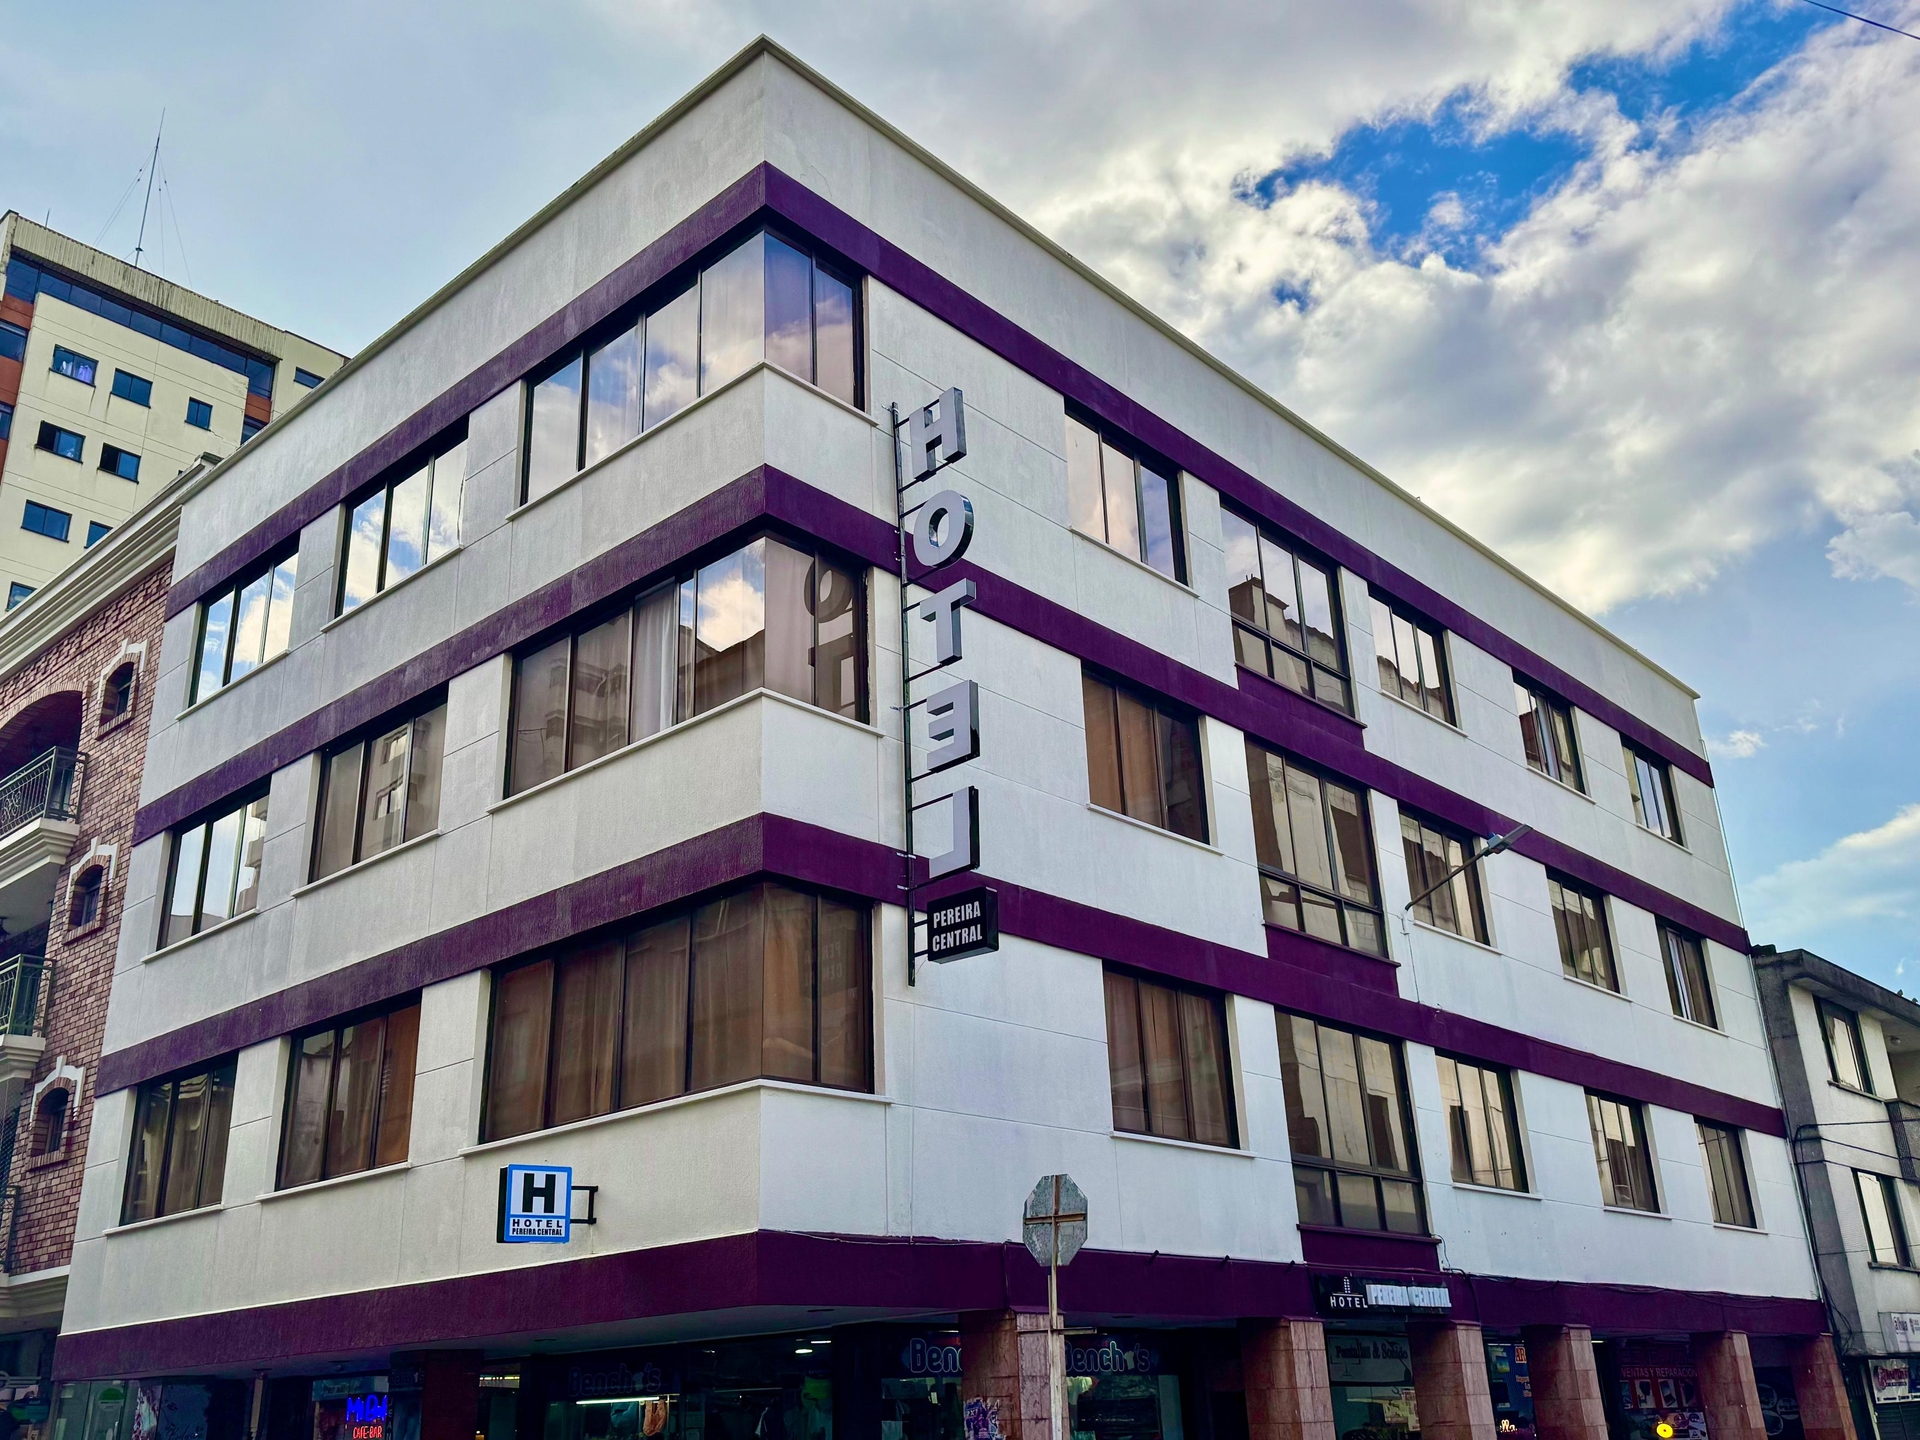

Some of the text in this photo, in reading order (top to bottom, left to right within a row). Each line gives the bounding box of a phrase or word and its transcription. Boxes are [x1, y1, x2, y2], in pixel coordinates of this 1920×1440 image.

[933, 901, 981, 929] PEREIRA
[932, 924, 983, 952] CENTRAL
[522, 1173, 556, 1213] H
[512, 1219, 563, 1228] HOTEL
[512, 1228, 536, 1236] PEREIRA
[1330, 1296, 1368, 1308] HOTEL
